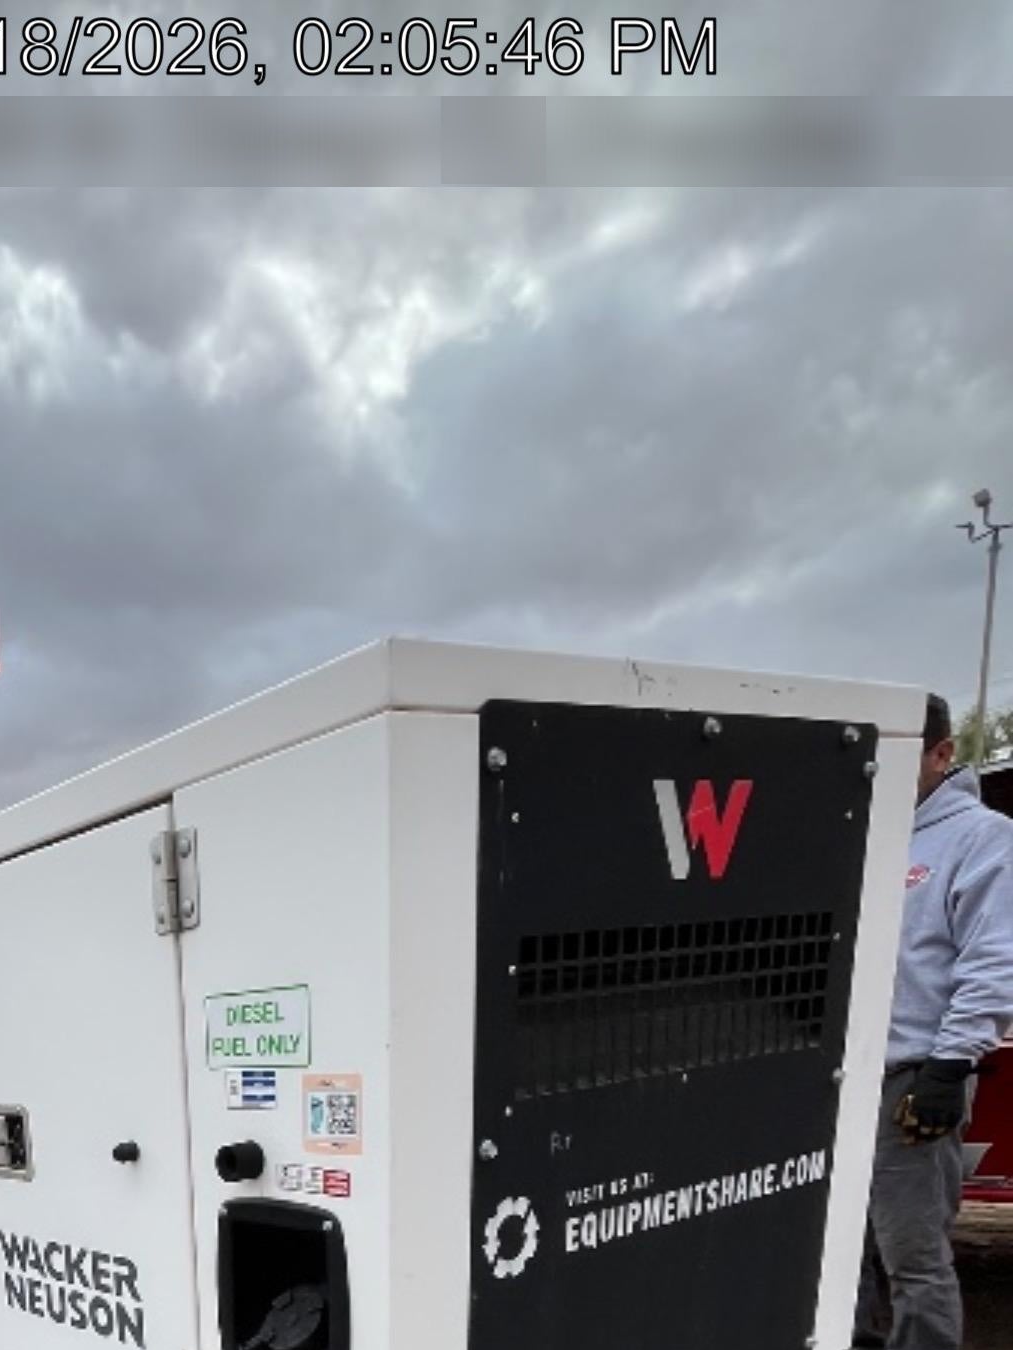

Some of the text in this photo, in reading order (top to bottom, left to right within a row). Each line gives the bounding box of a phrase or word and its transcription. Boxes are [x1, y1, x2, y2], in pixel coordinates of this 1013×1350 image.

[226, 1001, 285, 1026] DIESEL
[212, 1032, 302, 1056] FUEL ONLY
[564, 1149, 826, 1252] EQUIPMENTSHARE.COM
[566, 1171, 655, 1207] VISIT US AT:
[4, 1271, 146, 1350] NEUSON
